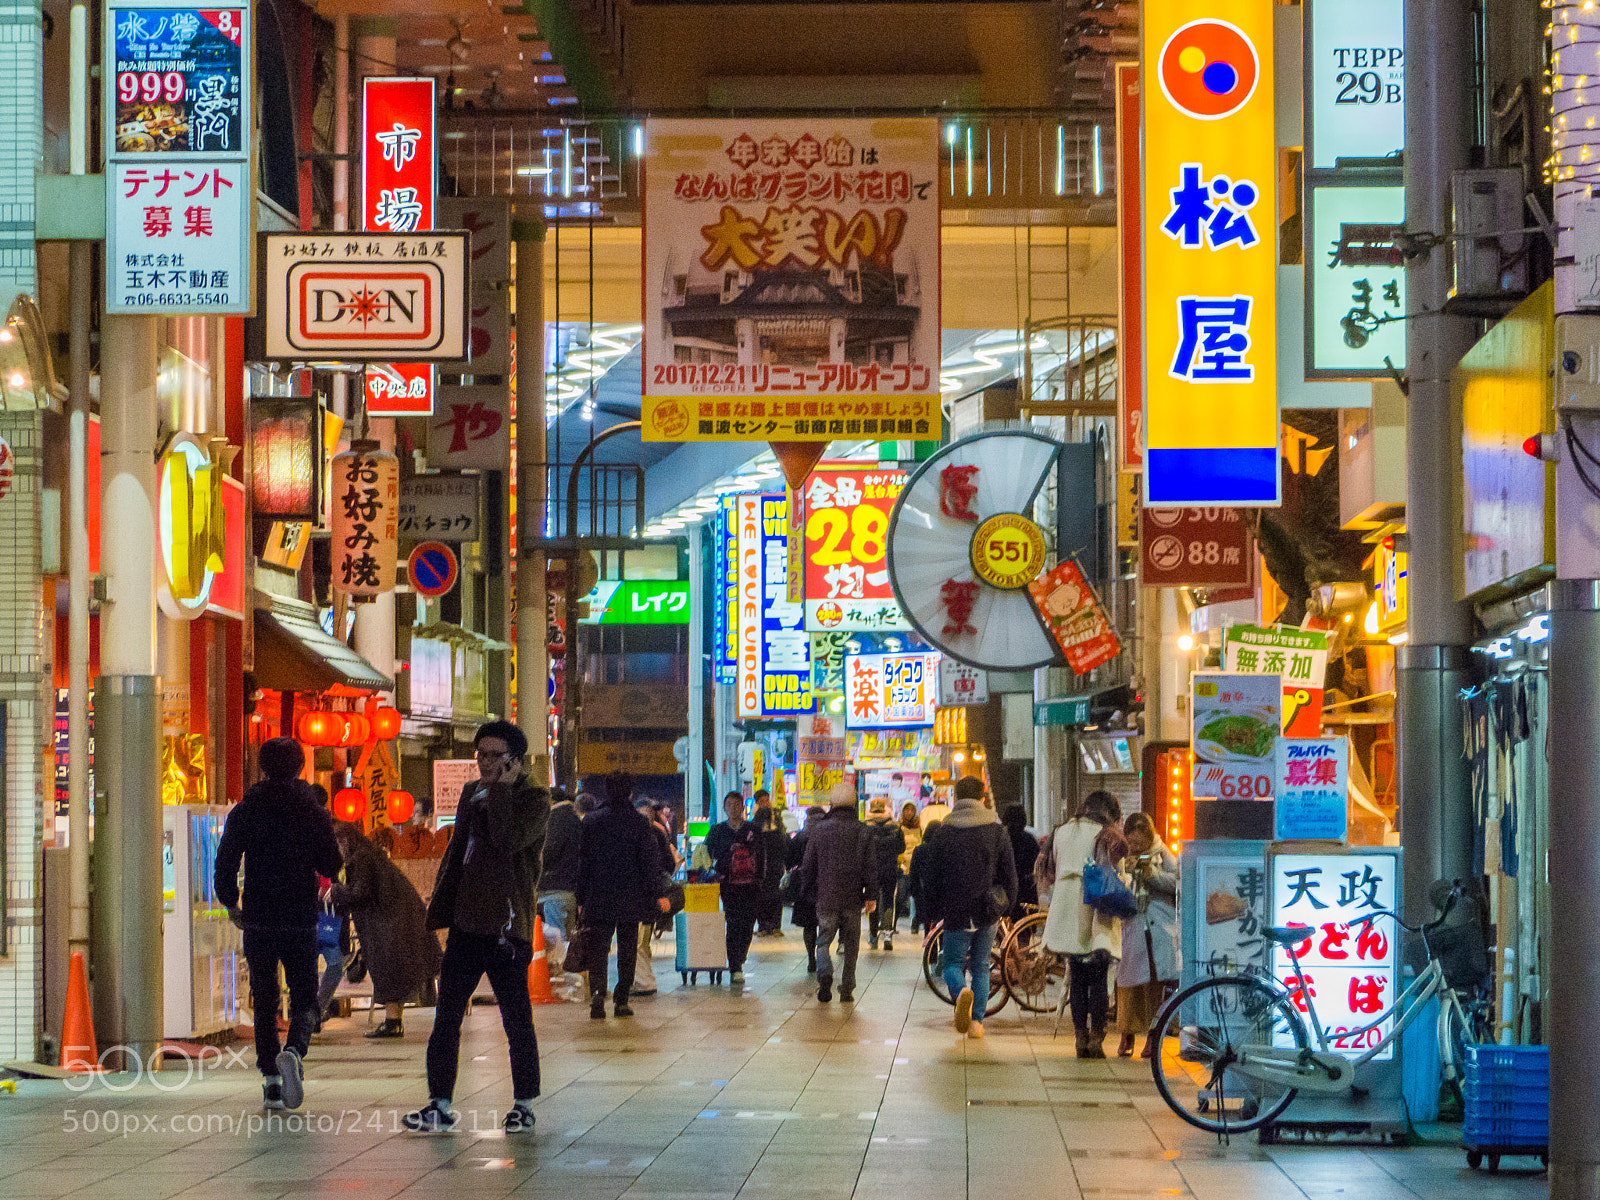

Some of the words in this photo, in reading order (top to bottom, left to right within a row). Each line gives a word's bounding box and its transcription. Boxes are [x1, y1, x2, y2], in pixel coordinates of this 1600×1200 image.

[218, 11, 240, 40] 3F
[1333, 48, 1404, 68] TEPP
[195, 75, 230, 150] 黒門
[124, 168, 233, 198] テナント
[674, 171, 932, 201] なんばグランド花月で
[143, 205, 213, 237] 募集
[125, 253, 185, 268] 株式会社
[283, 241, 335, 258] お好み
[392, 241, 448, 259] 居酒屋
[125, 270, 229, 289] 玉木不動産
[1161, 163, 1259, 383] 松屋
[312, 285, 419, 325] DON
[653, 364, 745, 385] 2017.12.21
[751, 364, 931, 393] リニューアルオープン
[806, 477, 863, 509] 全品
[341, 455, 383, 586] お好み焼
[806, 504, 895, 566] 28
[989, 540, 1029, 563] 551
[1188, 541, 1241, 565] 88席
[632, 591, 687, 612] レイク
[1236, 646, 1313, 680] 無添加
[765, 675, 799, 692] DVD
[853, 658, 879, 719] 薬
[764, 692, 813, 710] VIDEO
[1287, 745, 1336, 758] アルバイト
[1284, 757, 1338, 786] 募集
[1220, 775, 1274, 798] 680
[1282, 864, 1388, 910] 天政
[1283, 920, 1388, 960] うどん
